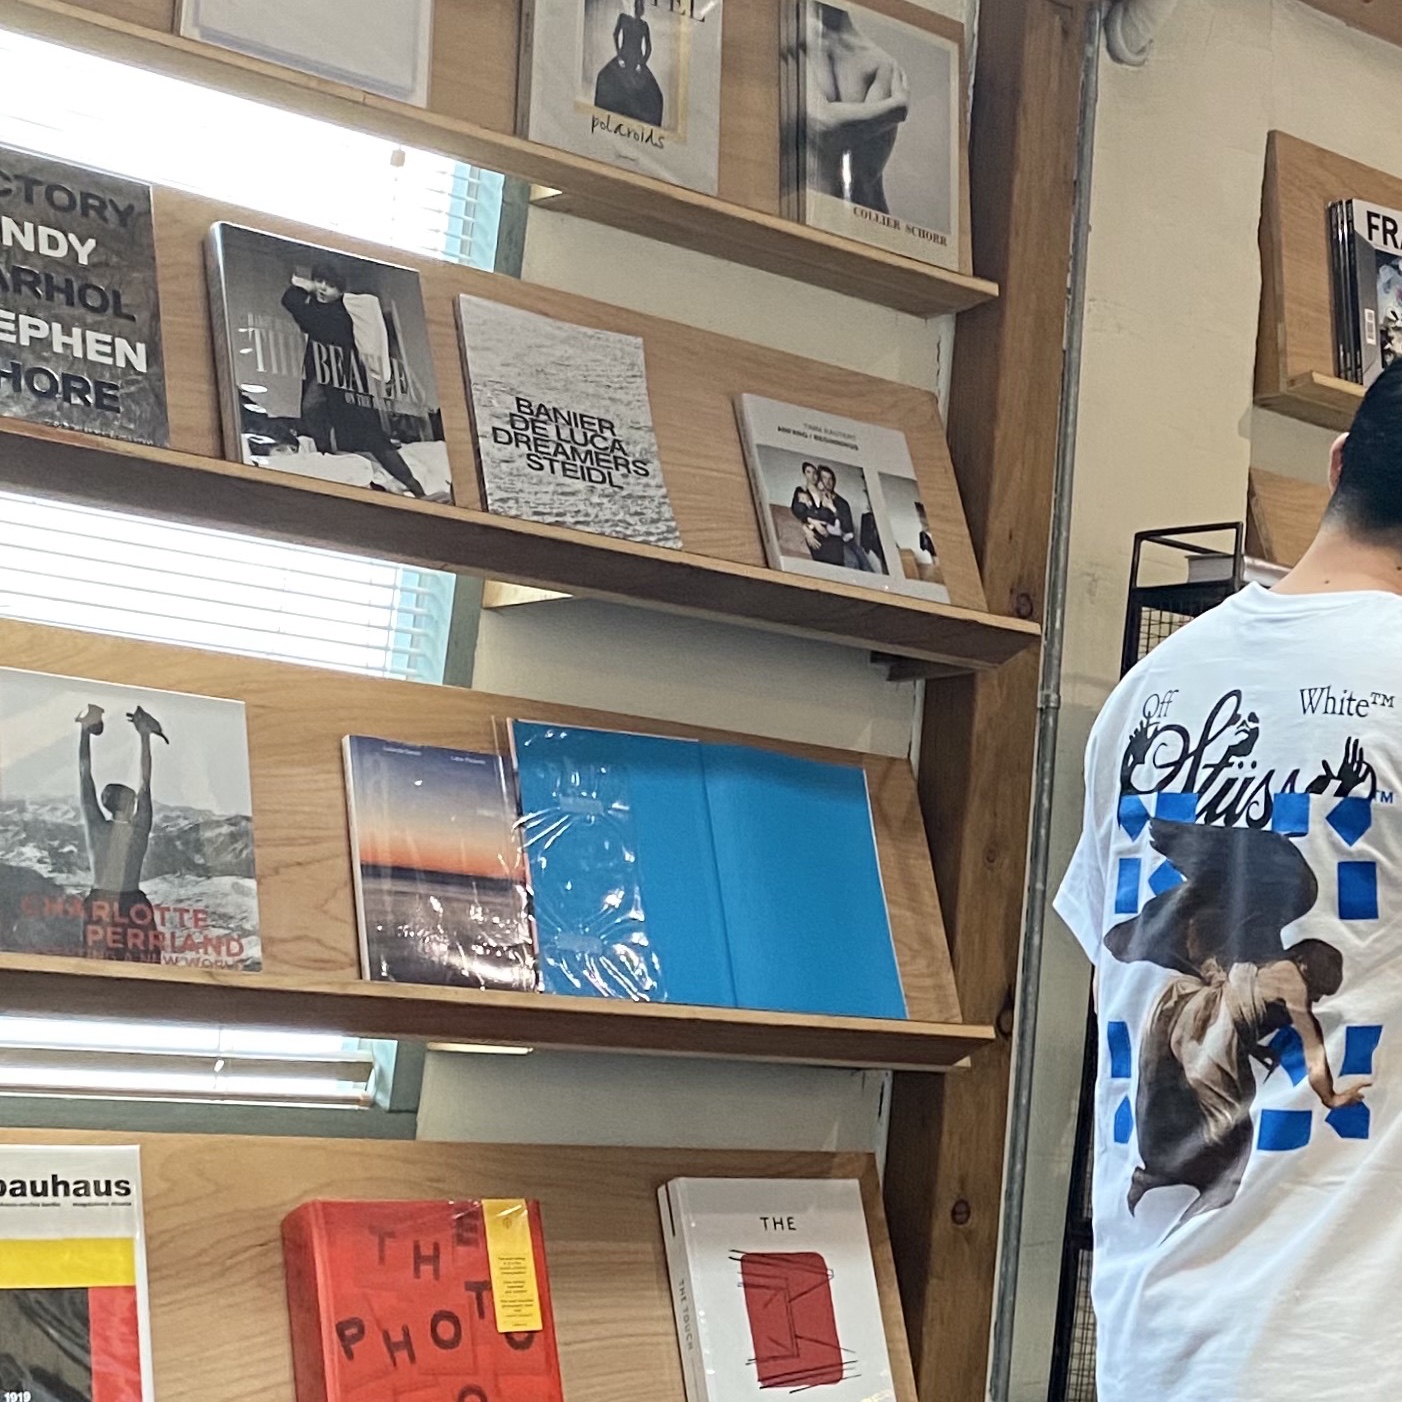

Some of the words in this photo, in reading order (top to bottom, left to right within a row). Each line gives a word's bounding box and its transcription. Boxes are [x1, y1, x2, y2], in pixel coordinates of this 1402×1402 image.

[591, 114, 666, 149] polaroids
[852, 205, 901, 230] COLLIER
[904, 222, 948, 247] SCHORR
[509, 413, 549, 438] DE
[555, 425, 629, 456] LUCA
[515, 397, 616, 436] BANIER
[492, 426, 650, 477] DREAMERS
[526, 453, 624, 490] STEIDL
[1143, 689, 1180, 719] Off
[21, 894, 209, 930] CHARLOTTE
[86, 925, 245, 957] PERRIAND
[760, 1217, 797, 1231] THE
[368, 1207, 480, 1281] THE
